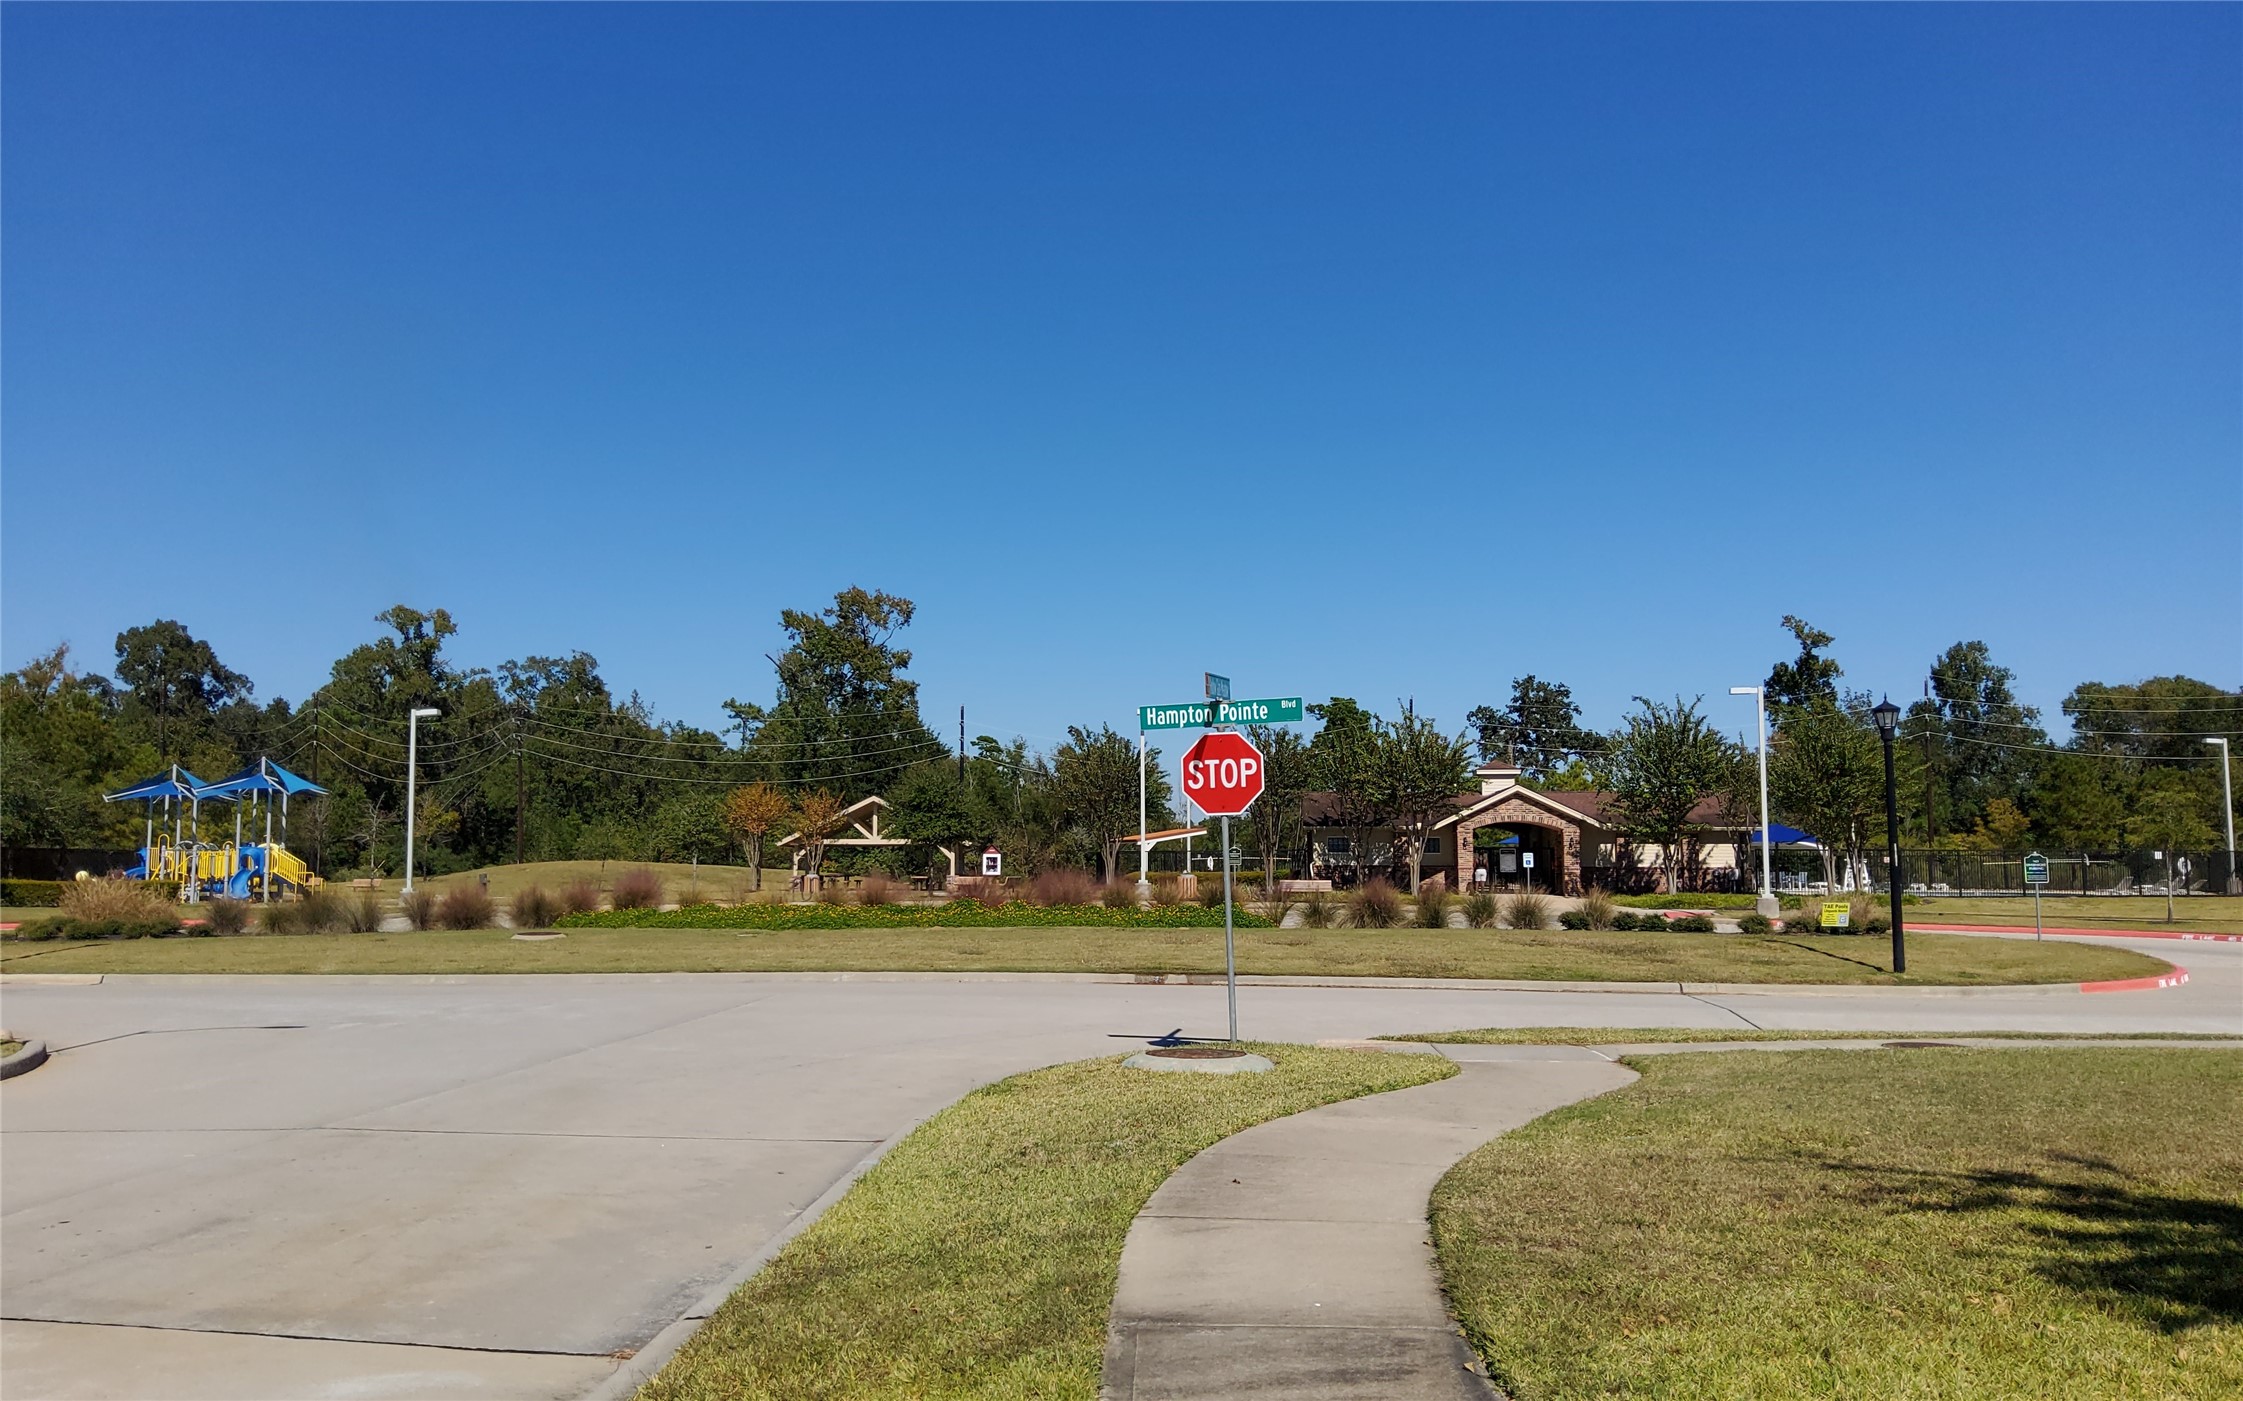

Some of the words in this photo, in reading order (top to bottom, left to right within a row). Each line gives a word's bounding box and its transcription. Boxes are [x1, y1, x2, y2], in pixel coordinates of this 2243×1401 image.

[1147, 707, 1213, 728] Hampton
[1219, 703, 1268, 721] Pointe
[1281, 700, 1296, 708] Blvd
[1187, 758, 1257, 790] STOP
